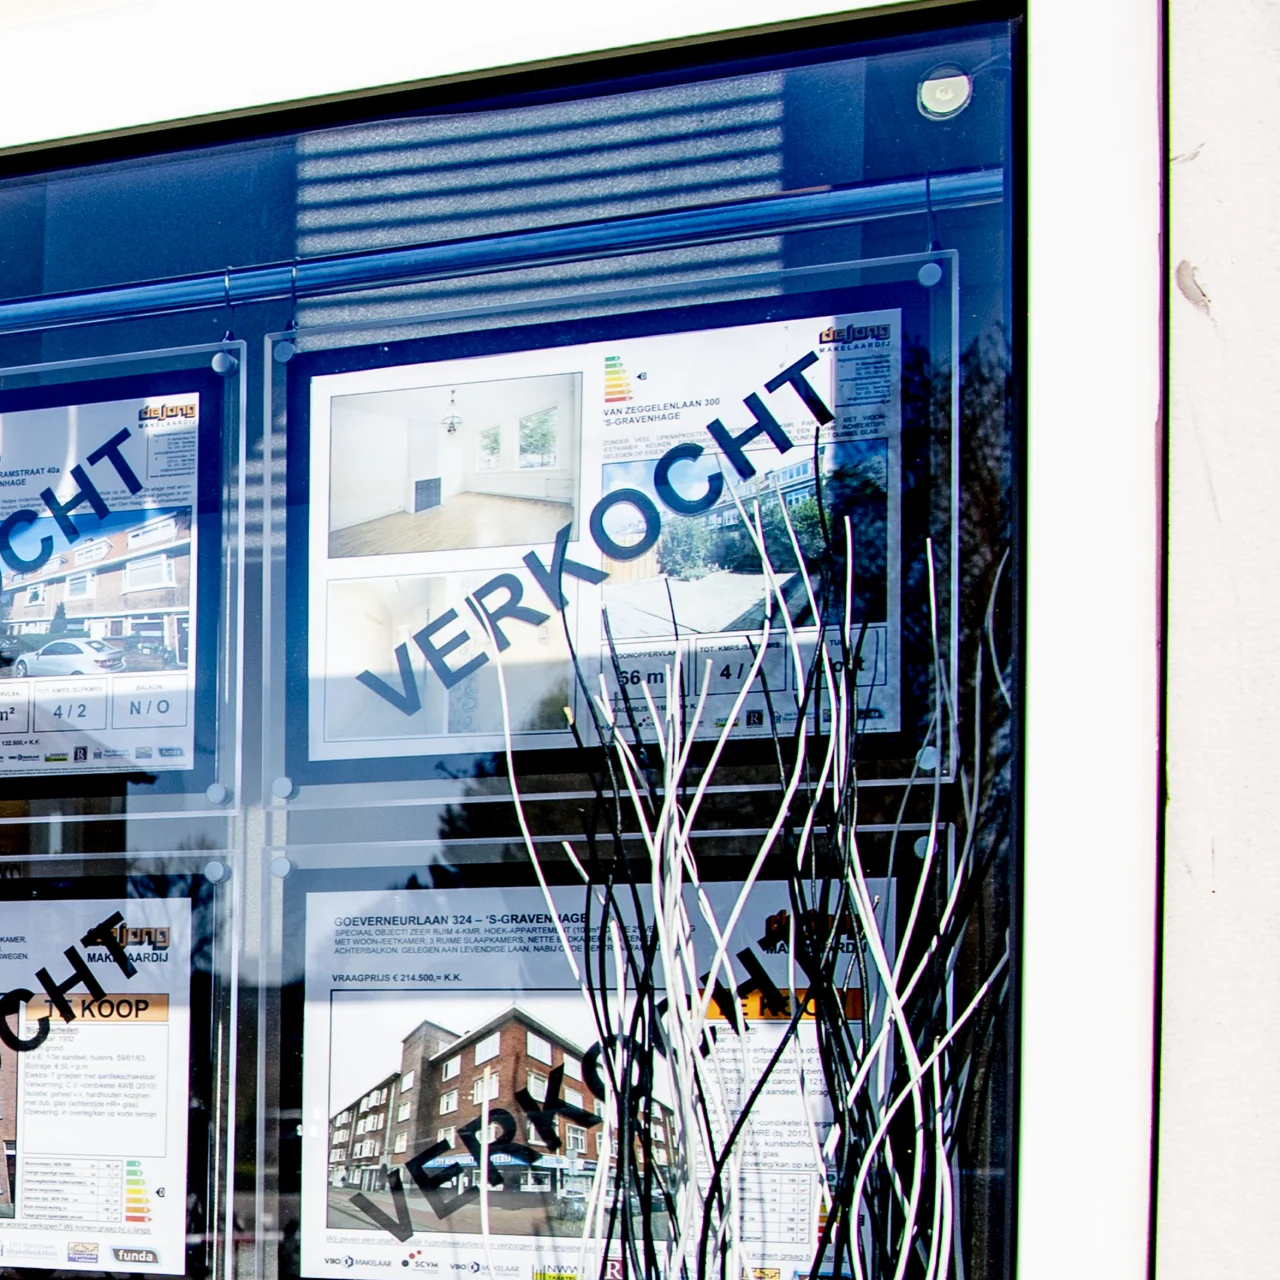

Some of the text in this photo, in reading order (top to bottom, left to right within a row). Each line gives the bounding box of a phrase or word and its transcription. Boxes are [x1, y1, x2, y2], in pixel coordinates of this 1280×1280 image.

[819, 341, 890, 353] MAKELAARDIJ
[604, 398, 720, 416] VAN ZEGGELENLAAN 300
[603, 412, 681, 426] 'S-GRAVENHAGE
[356, 351, 834, 717] VERKOCHT
[53, 704, 86, 718] 4 2
[130, 700, 169, 715] N O
[334, 916, 449, 927] GOEVERNEURLAAN
[452, 915, 472, 925] 324
[332, 973, 462, 982] VRAAGPRIJS 214.500,= K.K.
[81, 999, 149, 1018] KOOP
[117, 1250, 154, 1262] funda
